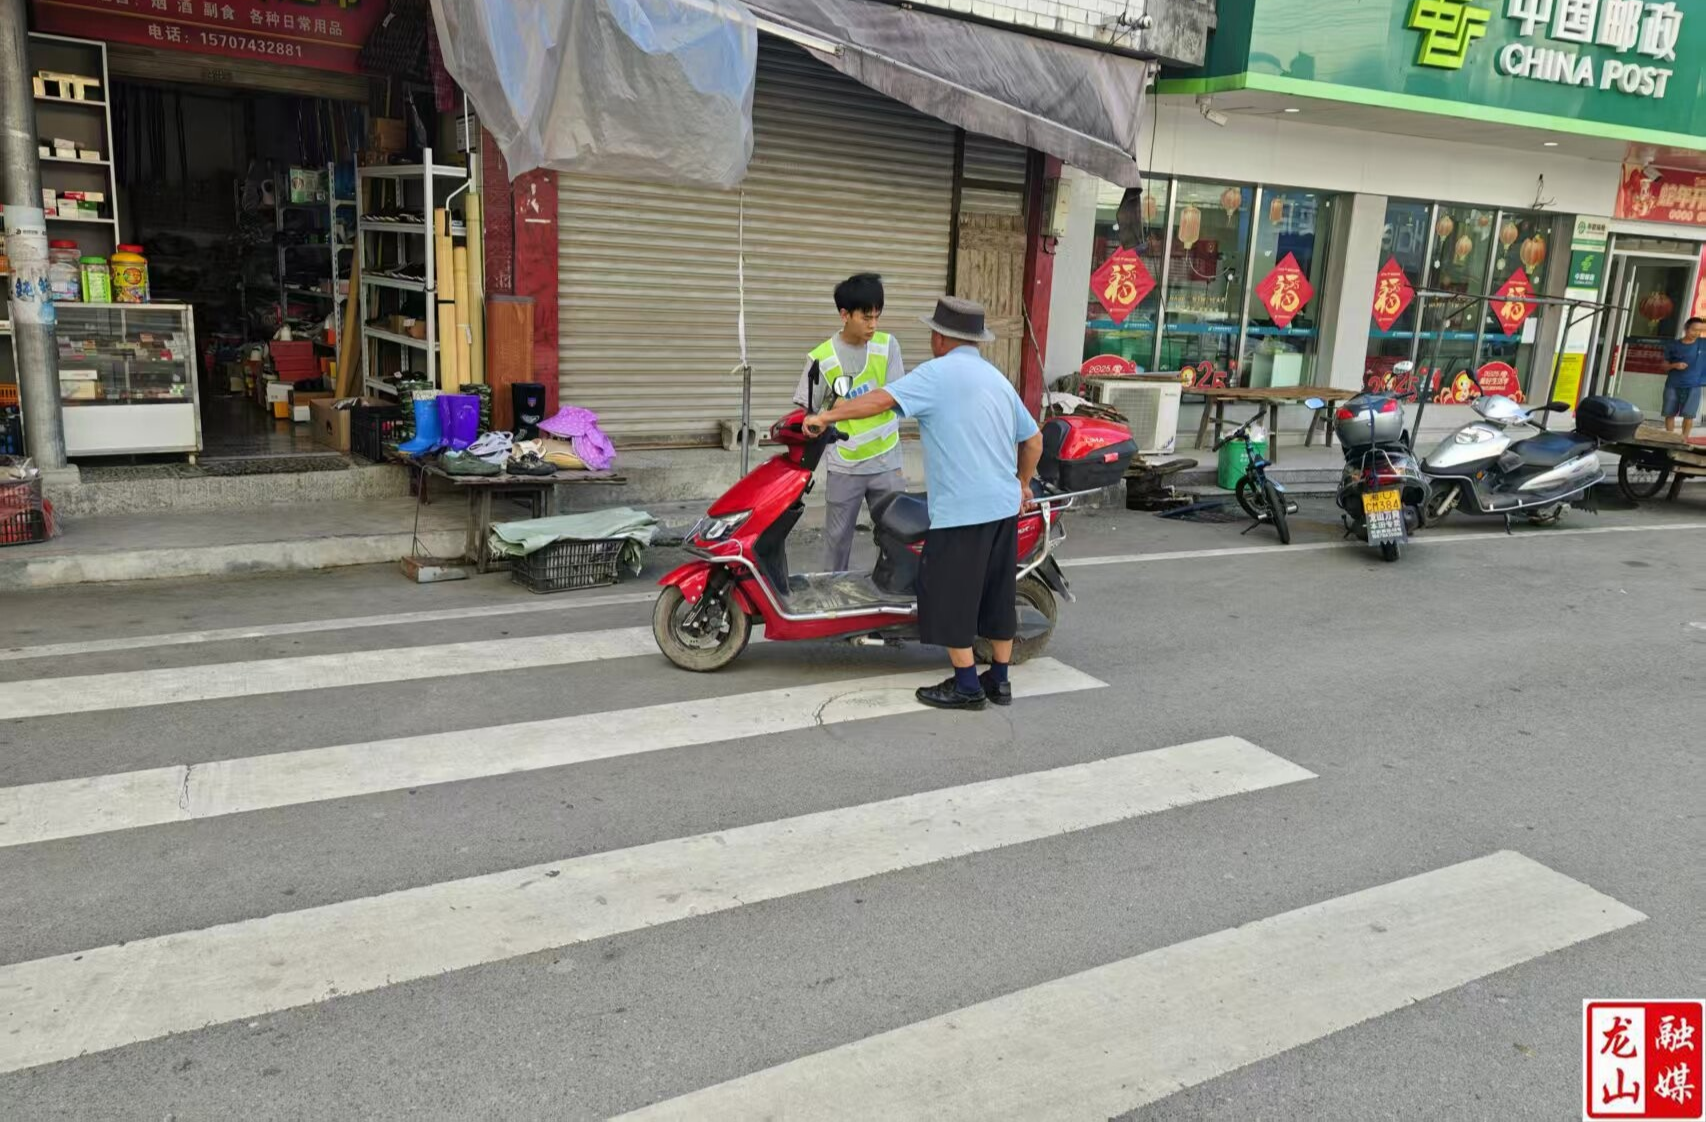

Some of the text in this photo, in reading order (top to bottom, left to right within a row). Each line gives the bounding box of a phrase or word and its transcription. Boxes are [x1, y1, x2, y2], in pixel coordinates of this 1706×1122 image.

[177, 1, 193, 14] 酒
[203, 2, 235, 21] 副食
[249, 8, 343, 37] 各种日常用品
[1505, 0, 1684, 62] 中国邮政
[1499, 43, 1674, 98] CHINA POST
[1104, 264, 1138, 305] 福
[1269, 274, 1300, 312] 福
[1374, 278, 1401, 315] 福
[1500, 286, 1526, 321] 福
